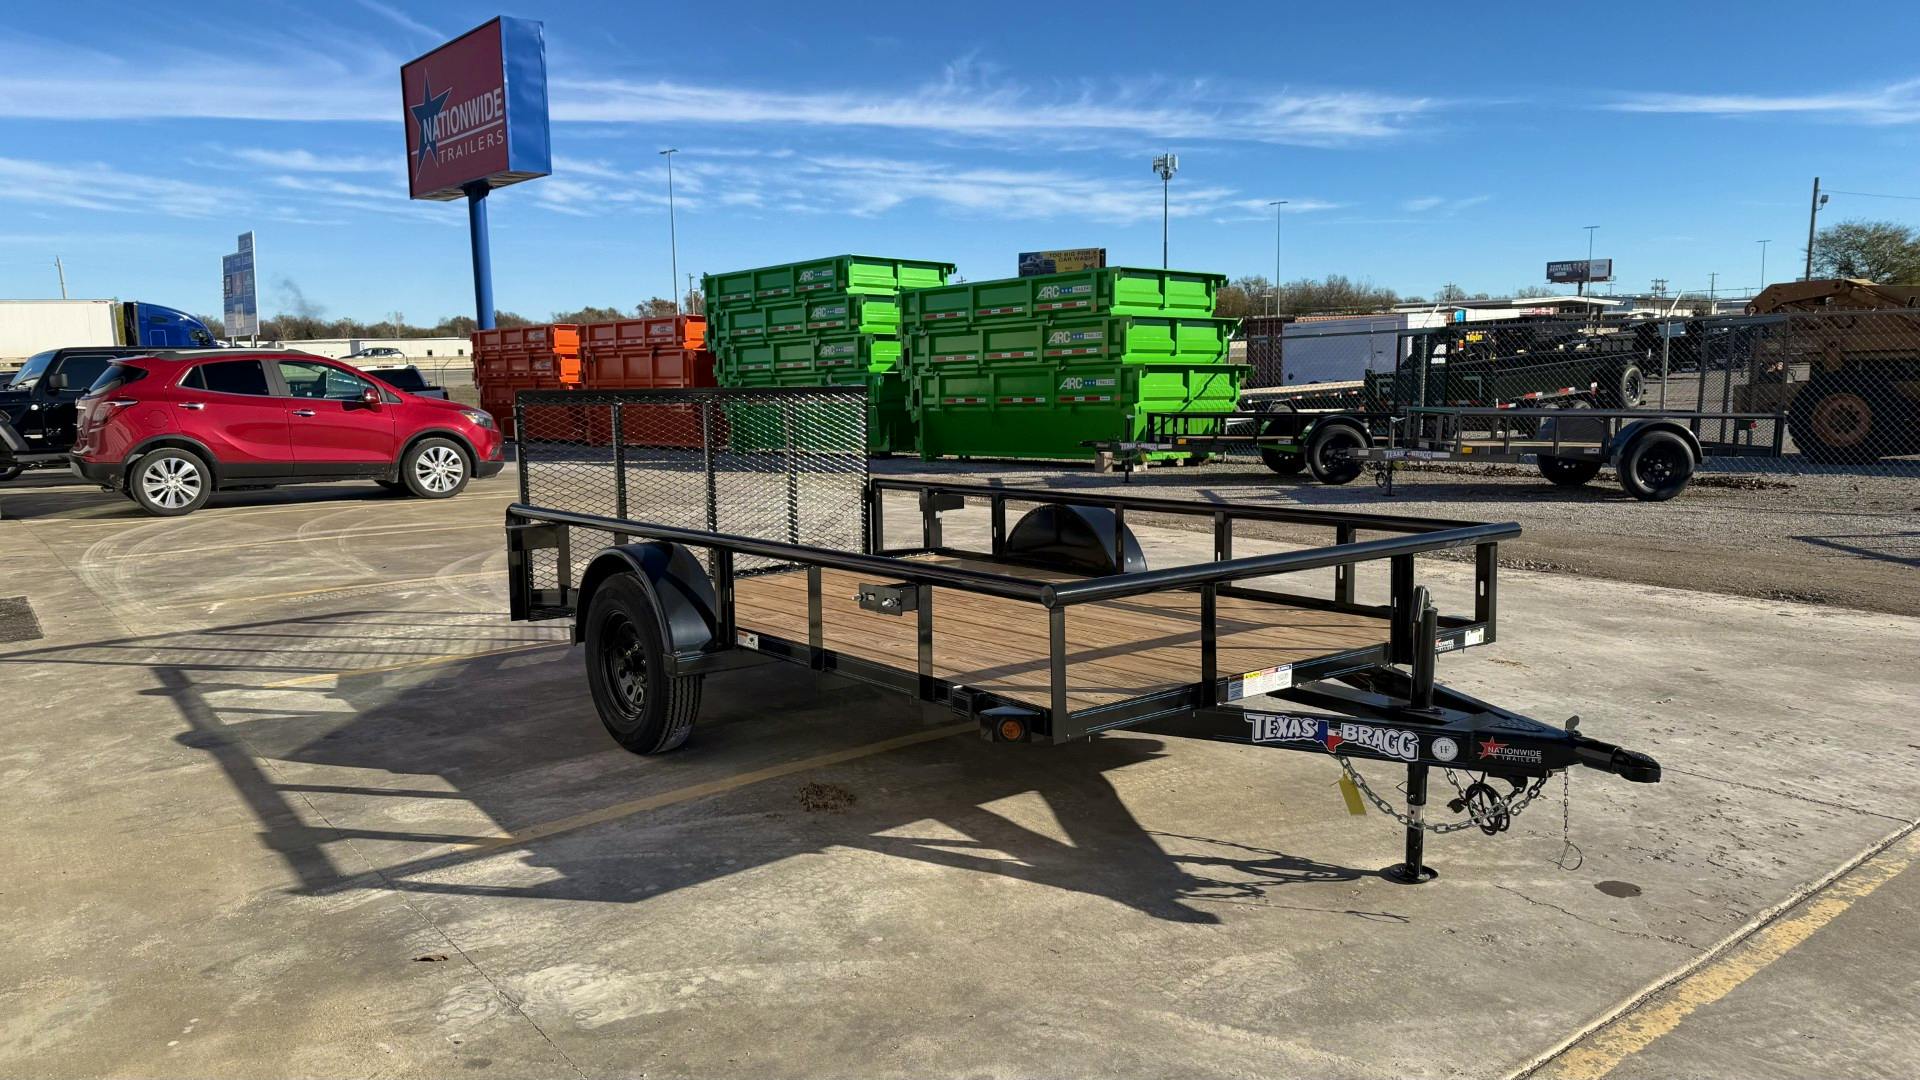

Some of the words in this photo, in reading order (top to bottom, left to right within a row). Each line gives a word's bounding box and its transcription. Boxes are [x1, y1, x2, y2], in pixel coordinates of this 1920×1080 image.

[423, 88, 503, 144] NATIONWIDE
[439, 130, 504, 164] TRAILERS
[799, 270, 814, 282] ARC
[1036, 286, 1060, 299] ARC
[811, 307, 827, 319] ARC
[1048, 331, 1071, 344] ARC
[1059, 377, 1083, 390] ARC
[1244, 712, 1319, 742] TEXAS
[1341, 723, 1420, 762] BRAGG
[1488, 746, 1542, 757] NATIONWIDE
[1502, 756, 1542, 764] TRAILERS
